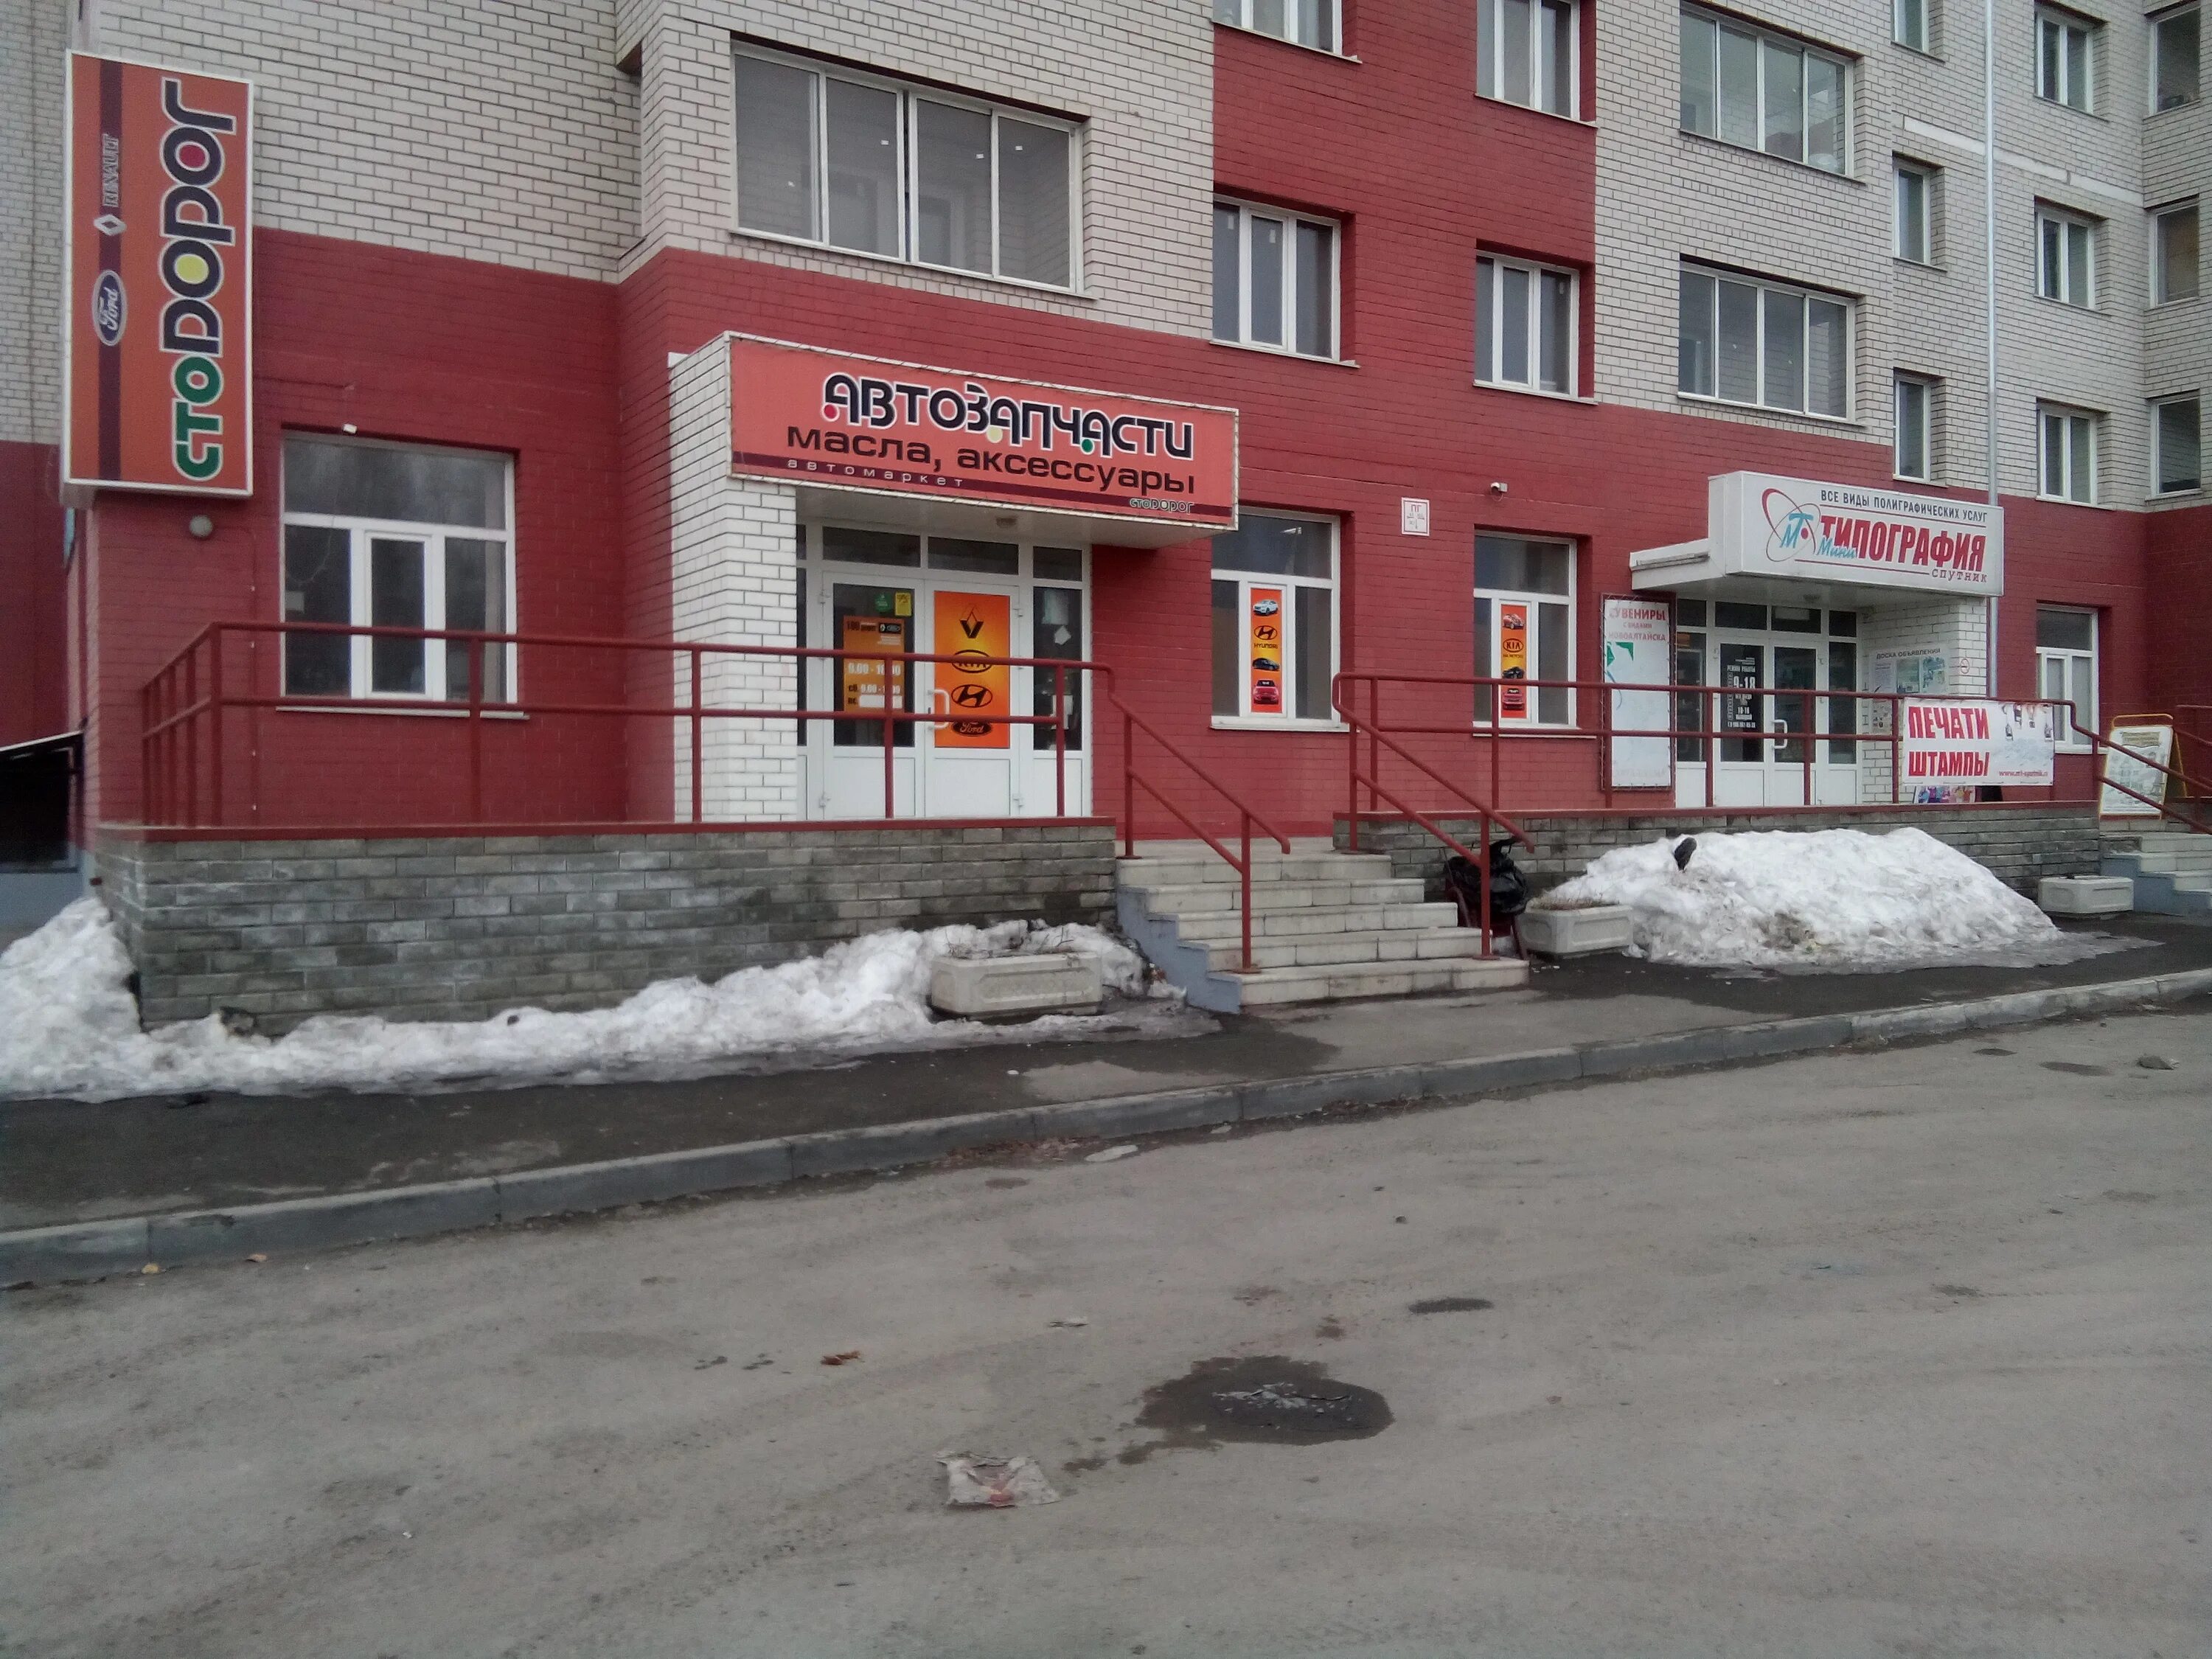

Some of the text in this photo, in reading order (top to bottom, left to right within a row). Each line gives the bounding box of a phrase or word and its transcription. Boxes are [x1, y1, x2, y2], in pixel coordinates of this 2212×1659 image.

[101, 133, 119, 208] RENAULT
[99, 288, 119, 332] Ford
[822, 371, 1194, 461] АВТОЗАПЧАСТИ
[787, 425, 1195, 495] масла, аксессуары
[787, 459, 963, 487] автомаркет
[1820, 489, 1989, 523] ВСЕ ВИДЫ ПОЛИГРАФИЧЕСКИХ УСЛУГ
[1820, 515, 1987, 573] ТИПОГРАФИЯ
[1609, 608, 1666, 622] СУВЕНИРЫ
[1506, 641, 1520, 650] KIA
[1877, 652, 1897, 660] ДОСКА
[1908, 706, 1990, 740] ПЕЧАТИ
[1907, 751, 1990, 777] ШТАМПЫ
